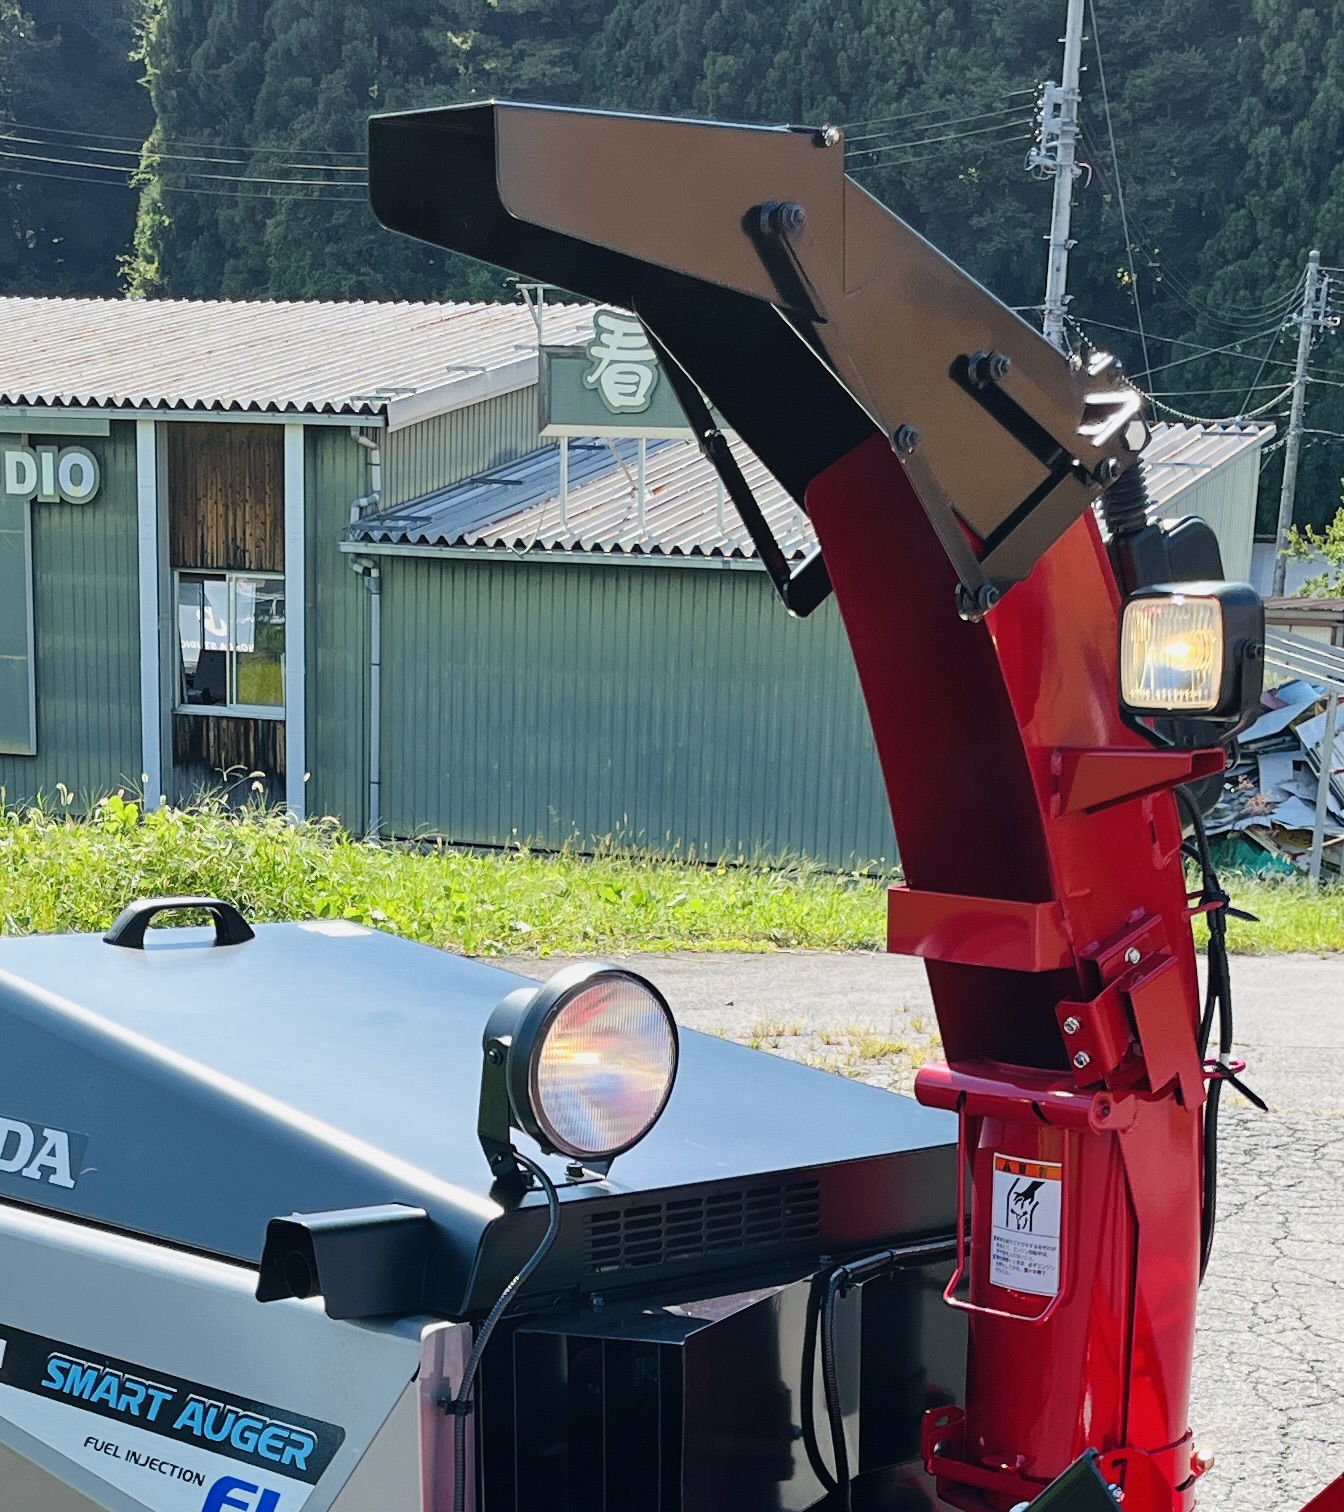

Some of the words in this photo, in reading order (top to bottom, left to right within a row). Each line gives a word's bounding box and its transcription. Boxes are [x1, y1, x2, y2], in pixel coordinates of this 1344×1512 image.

[586, 311, 657, 409] 看
[41, 1352, 178, 1422] SMART
[173, 1395, 318, 1471] AUGER
[83, 1436, 121, 1459] FUEL
[124, 1449, 206, 1487] INJECTION
